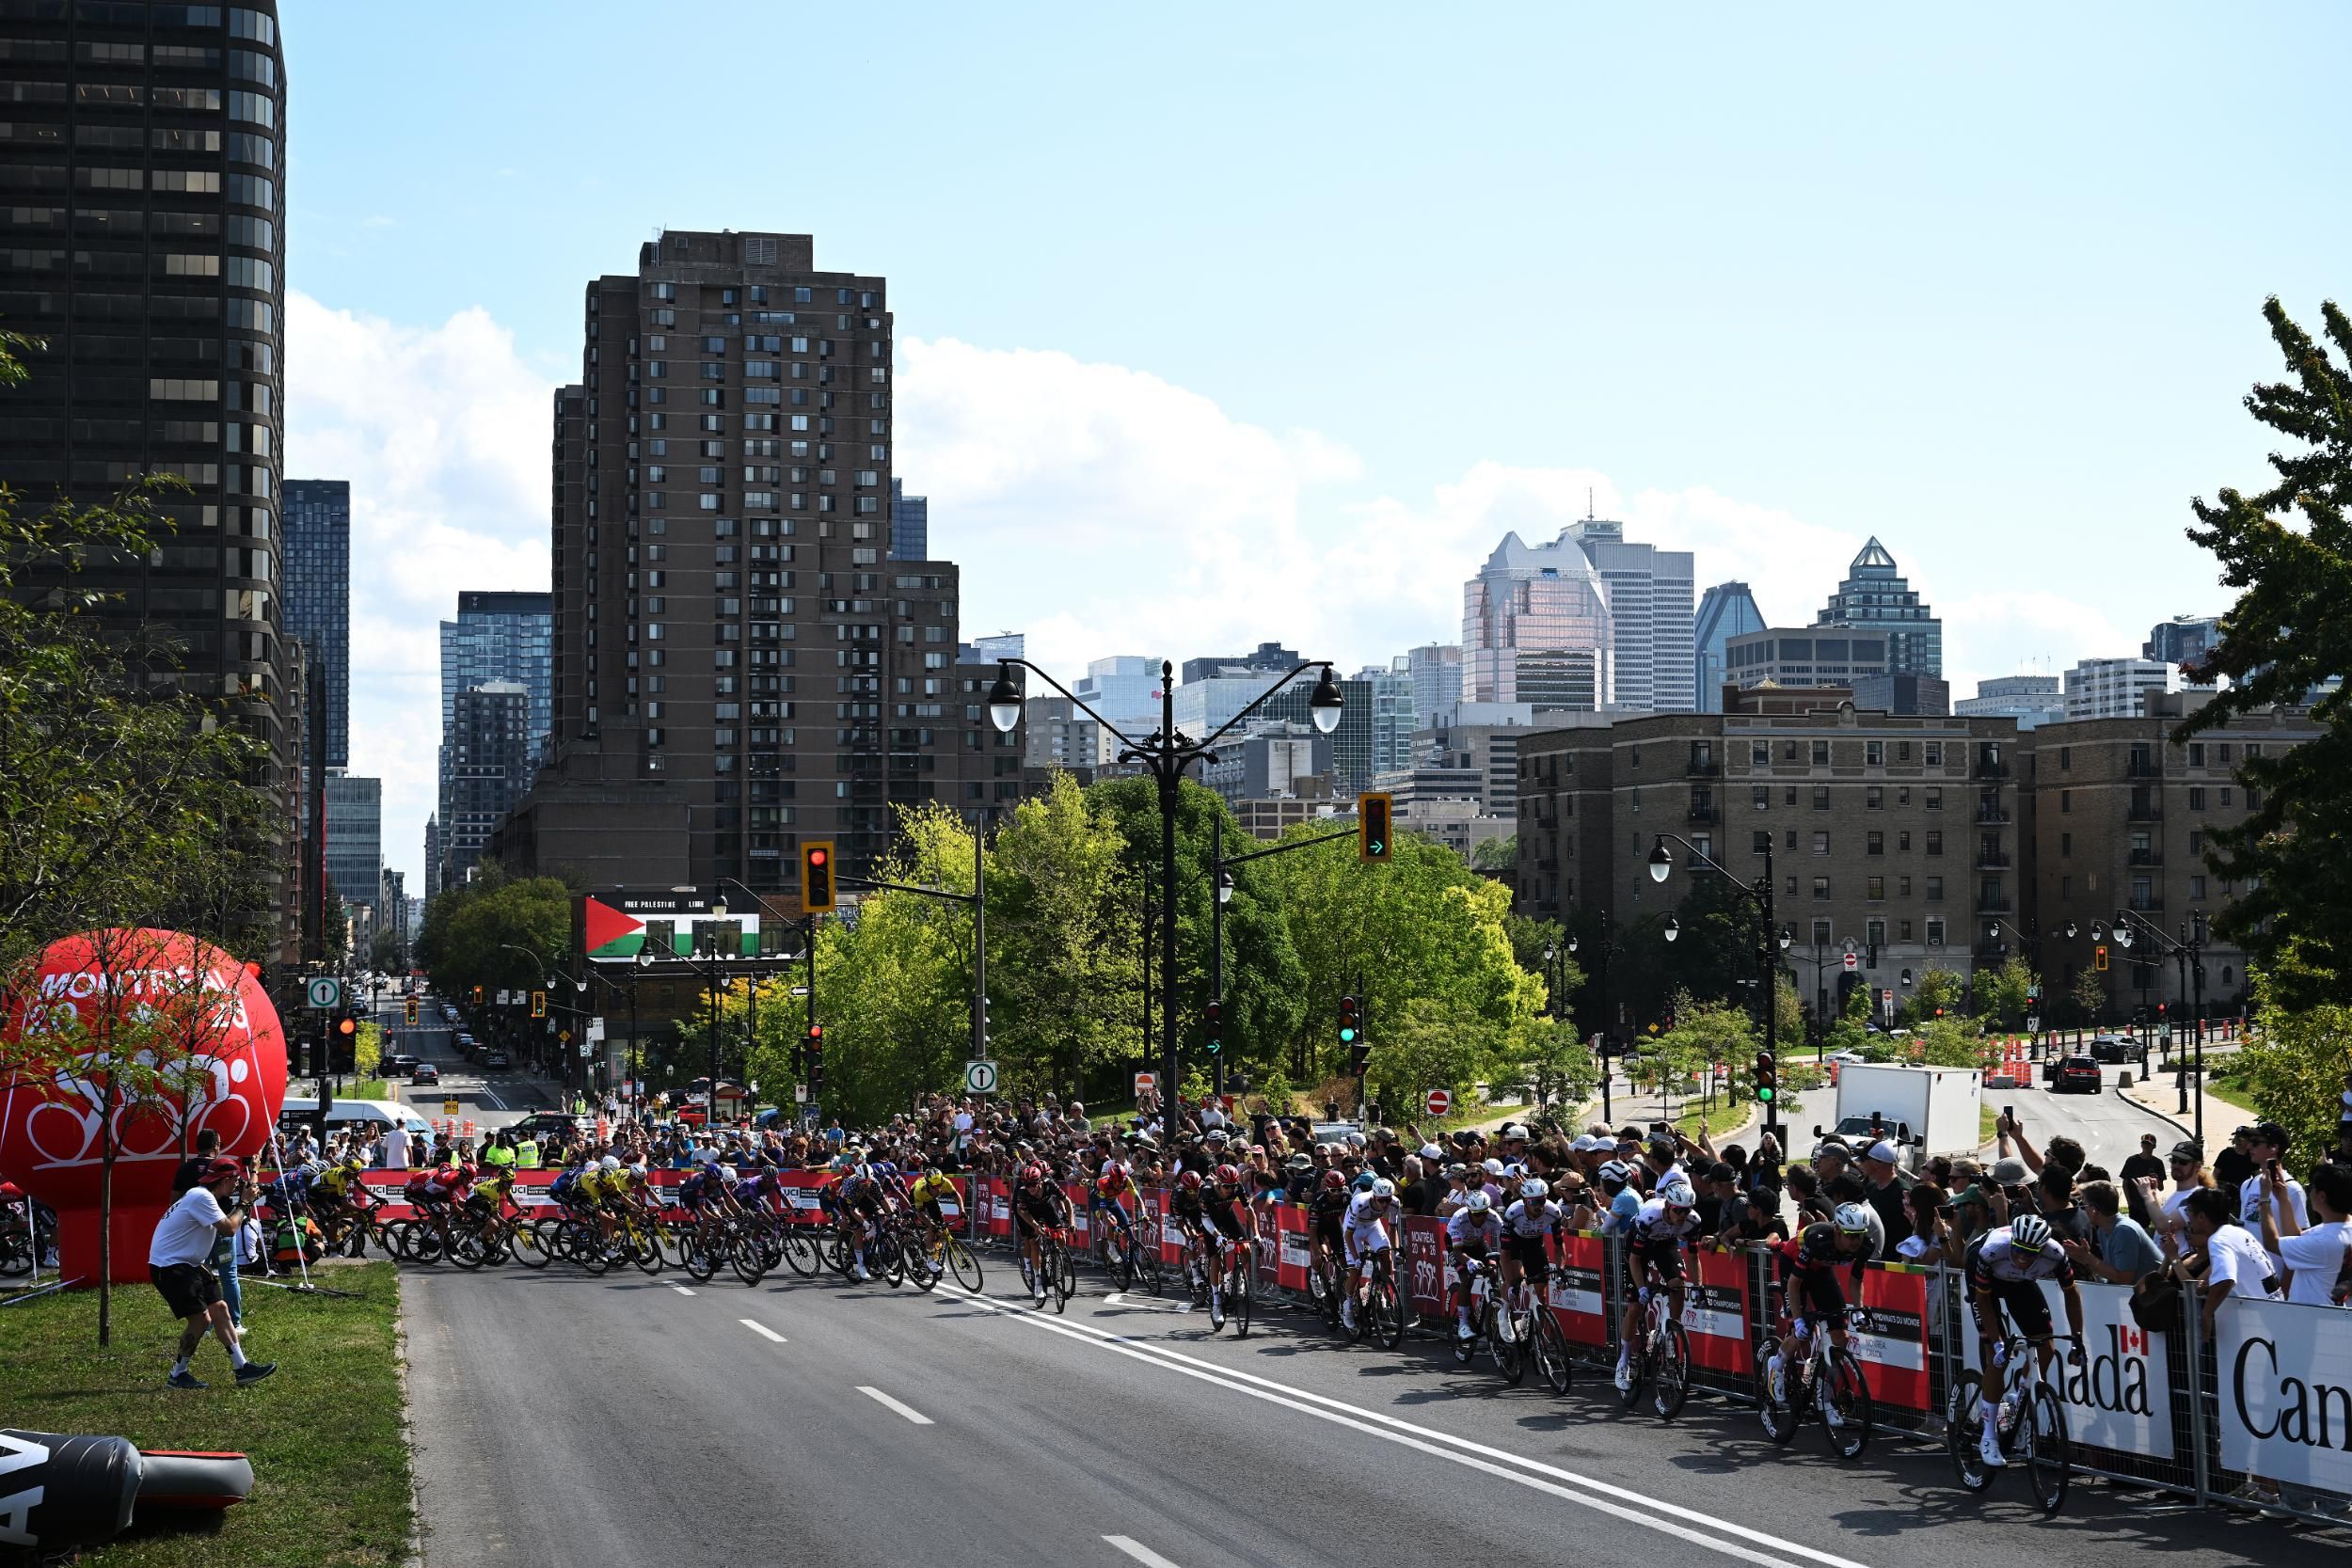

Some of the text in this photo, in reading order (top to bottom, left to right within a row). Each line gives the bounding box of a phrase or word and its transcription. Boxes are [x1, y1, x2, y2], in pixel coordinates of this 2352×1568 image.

[641, 900, 675, 909] PALESTINE
[785, 1188, 799, 1196] UCI
[1411, 1230, 1436, 1243] MONTRÉAL
[1411, 1243, 1437, 1256] 20 26
[1713, 1300, 1741, 1310] CHAMPIONSHIPS
[1872, 1313, 1897, 1323] MPIONNATS
[1902, 1318, 1920, 1327] MONDE
[1972, 1302, 1982, 1326] UAE
